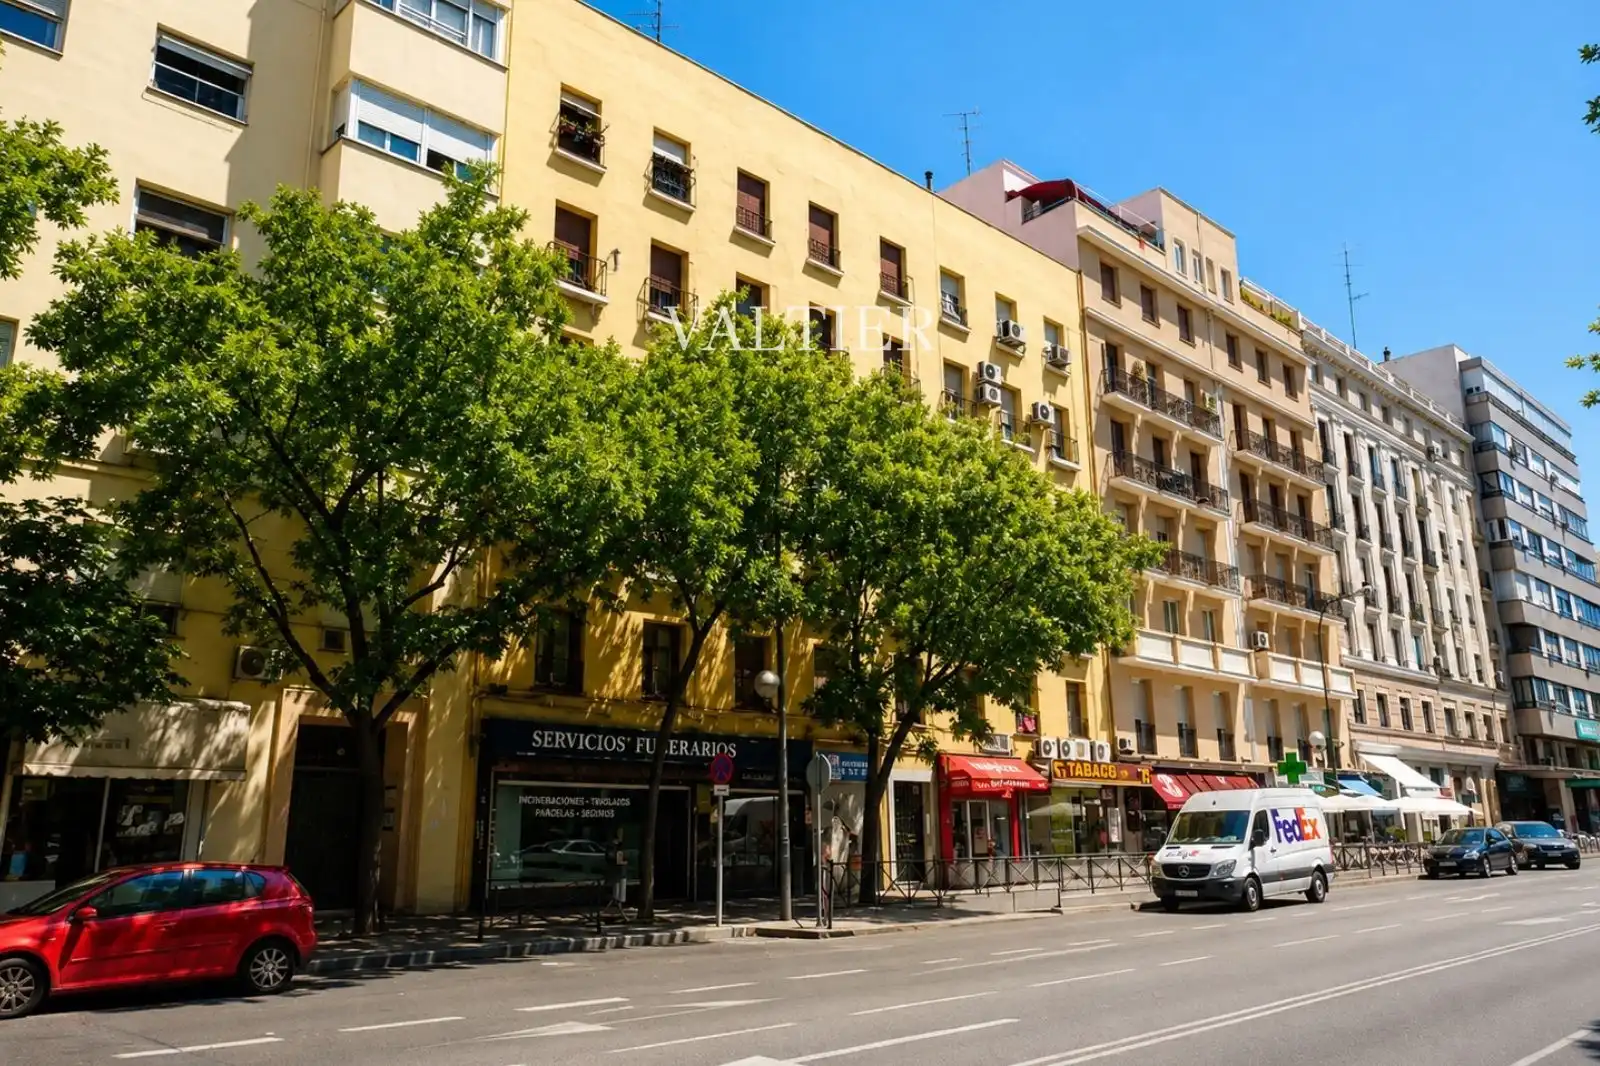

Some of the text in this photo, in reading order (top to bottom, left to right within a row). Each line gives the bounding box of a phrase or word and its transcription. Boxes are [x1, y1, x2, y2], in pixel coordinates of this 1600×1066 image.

[532, 730, 737, 758] SERVICIOS FUERARIOS
[1270, 807, 1322, 844] FedEx
